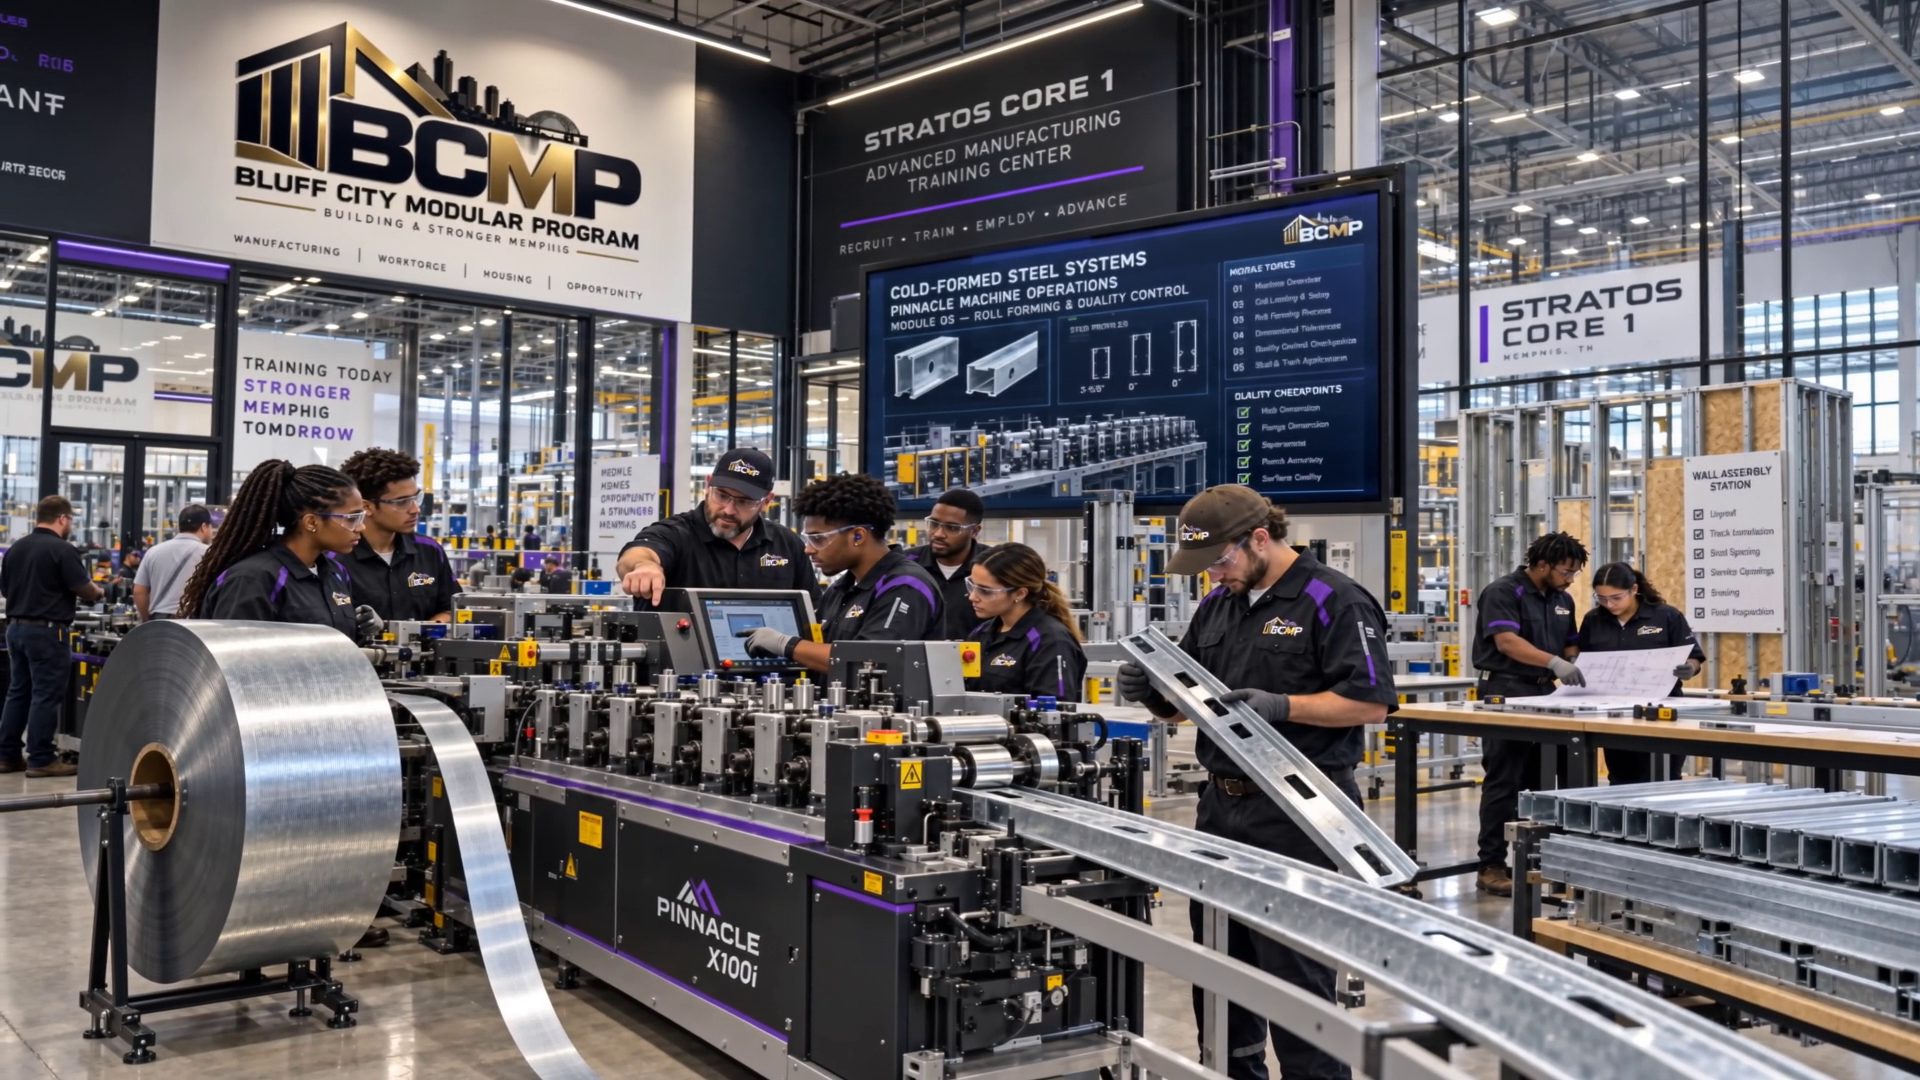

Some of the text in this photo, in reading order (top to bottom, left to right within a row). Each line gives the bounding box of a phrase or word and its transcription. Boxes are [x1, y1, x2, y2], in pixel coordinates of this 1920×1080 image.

[865, 69, 1114, 152] STRATOS CORE 1
[328, 98, 642, 220] BCMP
[866, 110, 1121, 183] ADVANCED MANUFACTURING
[908, 144, 1071, 193] TRAINING CENTER
[235, 165, 640, 250] BLUFF CITY MODULAR PROGRAM
[324, 208, 404, 229] BUILDING
[412, 222, 420, 231] &
[428, 224, 501, 244] STRONGER
[839, 236, 893, 255] RECRUIT
[1057, 193, 1128, 217] ADVANCE
[1300, 220, 1363, 243] BCMP
[891, 251, 1147, 300] COLD-FORMED STEEL SYSTEMS
[891, 276, 1118, 317] PINNACLE MACHINE OPERATIONS
[1233, 284, 1243, 293] 01
[891, 318, 936, 332] MODULE
[974, 308, 1003, 322] ROLL
[1007, 301, 1060, 317] FORMING
[1065, 300, 1073, 310] &
[1130, 284, 1190, 301] CONTROL
[1503, 278, 1682, 322] STRATOS
[1503, 313, 1635, 347] CORE 1
[243, 356, 393, 384] TRAINING TODAY
[243, 379, 350, 401] STRONGER
[1692, 470, 1718, 480] WALL
[1710, 480, 1751, 491] STATION
[657, 896, 761, 956] PINNACLE
[706, 946, 758, 988] X100i
